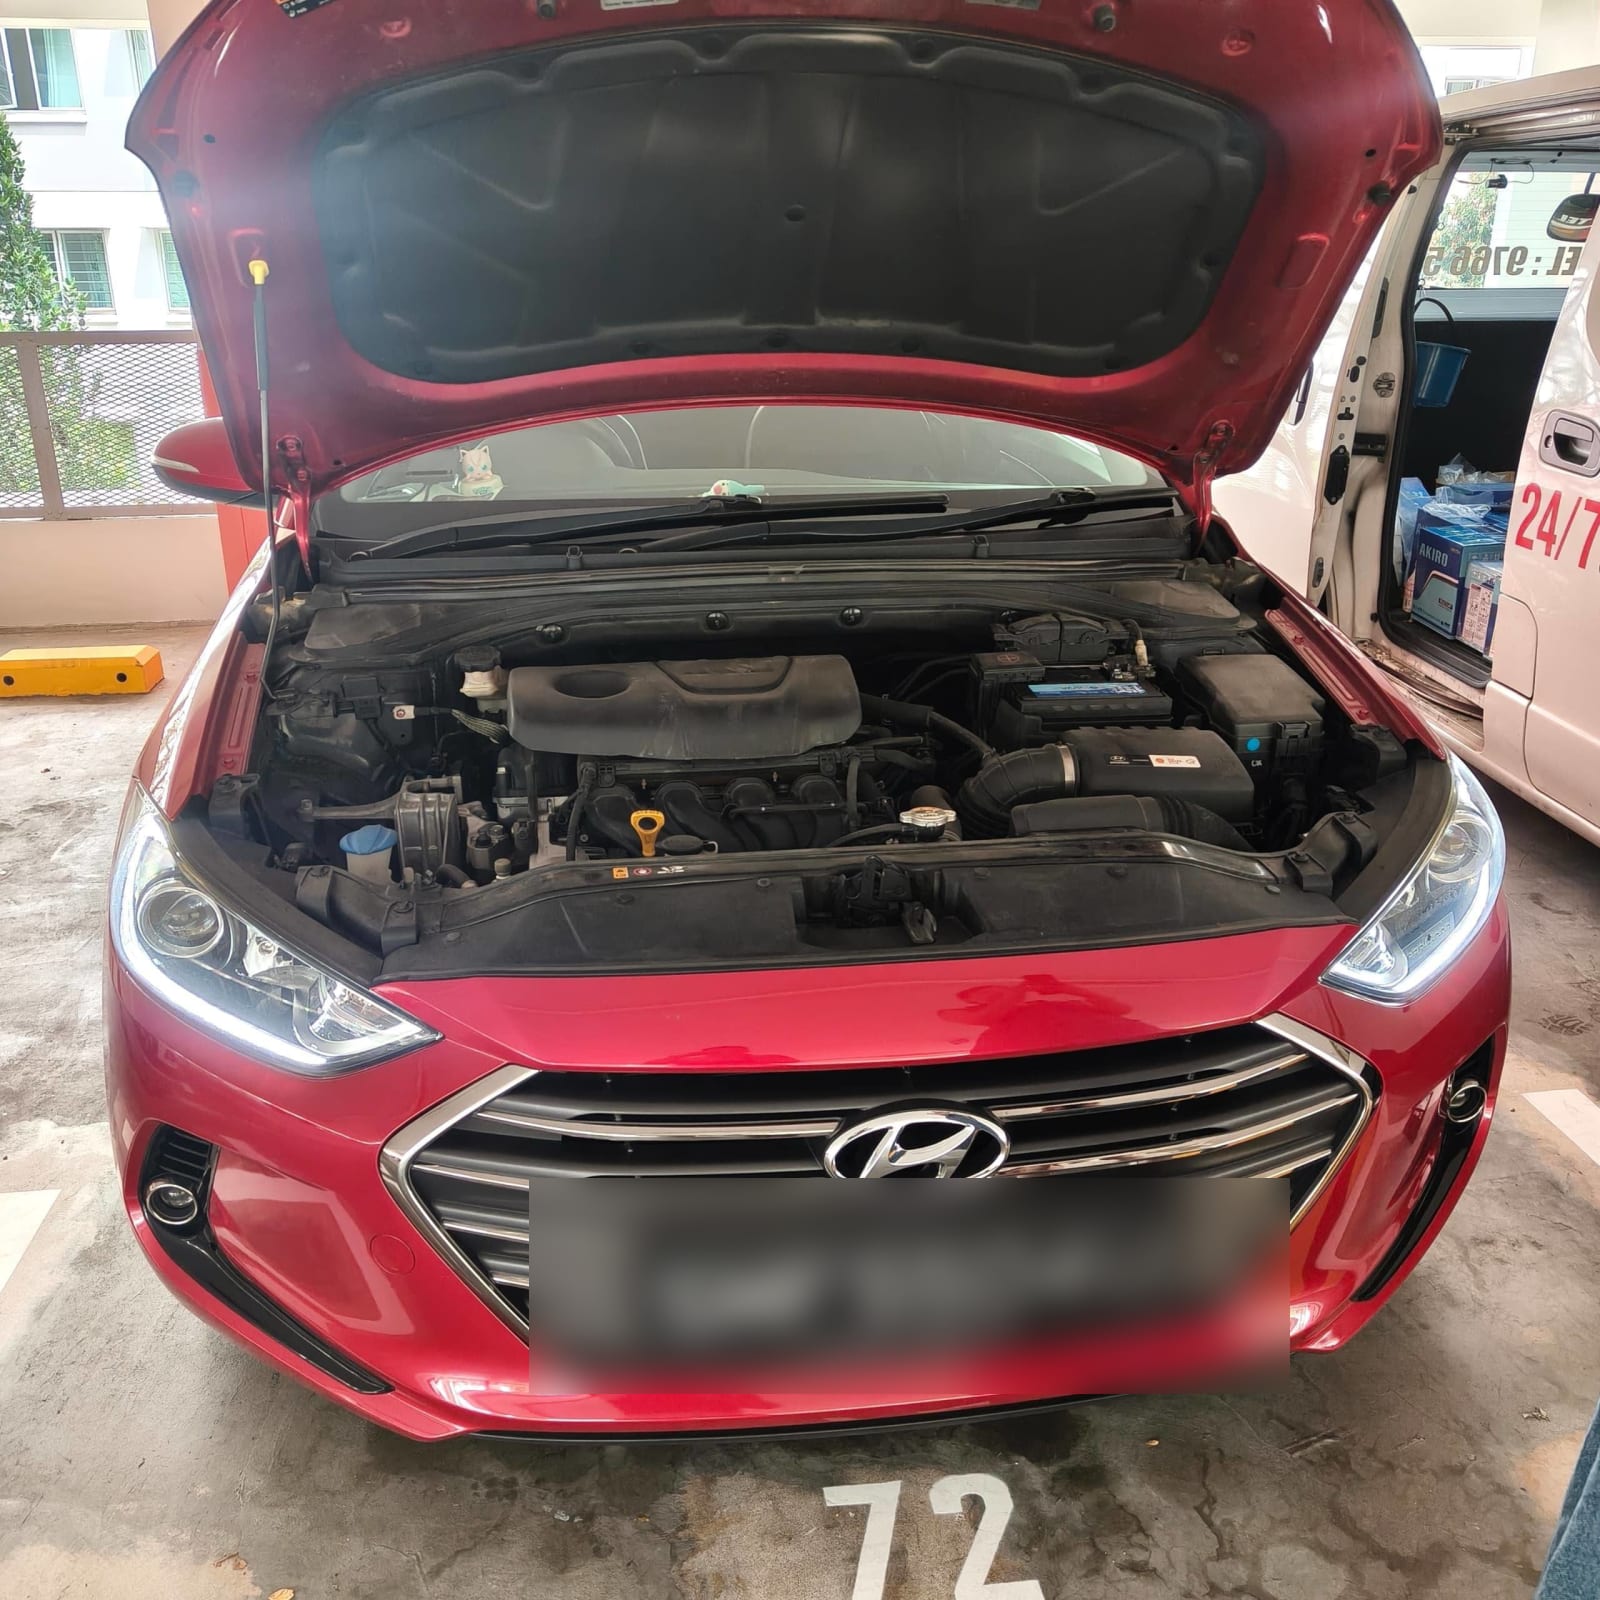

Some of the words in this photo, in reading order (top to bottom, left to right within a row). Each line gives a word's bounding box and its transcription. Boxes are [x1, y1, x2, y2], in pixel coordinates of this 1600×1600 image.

[1419, 543, 1448, 568] AKIRO
[1515, 483, 1600, 569] 24/7
[823, 1473, 1045, 1600] 72
